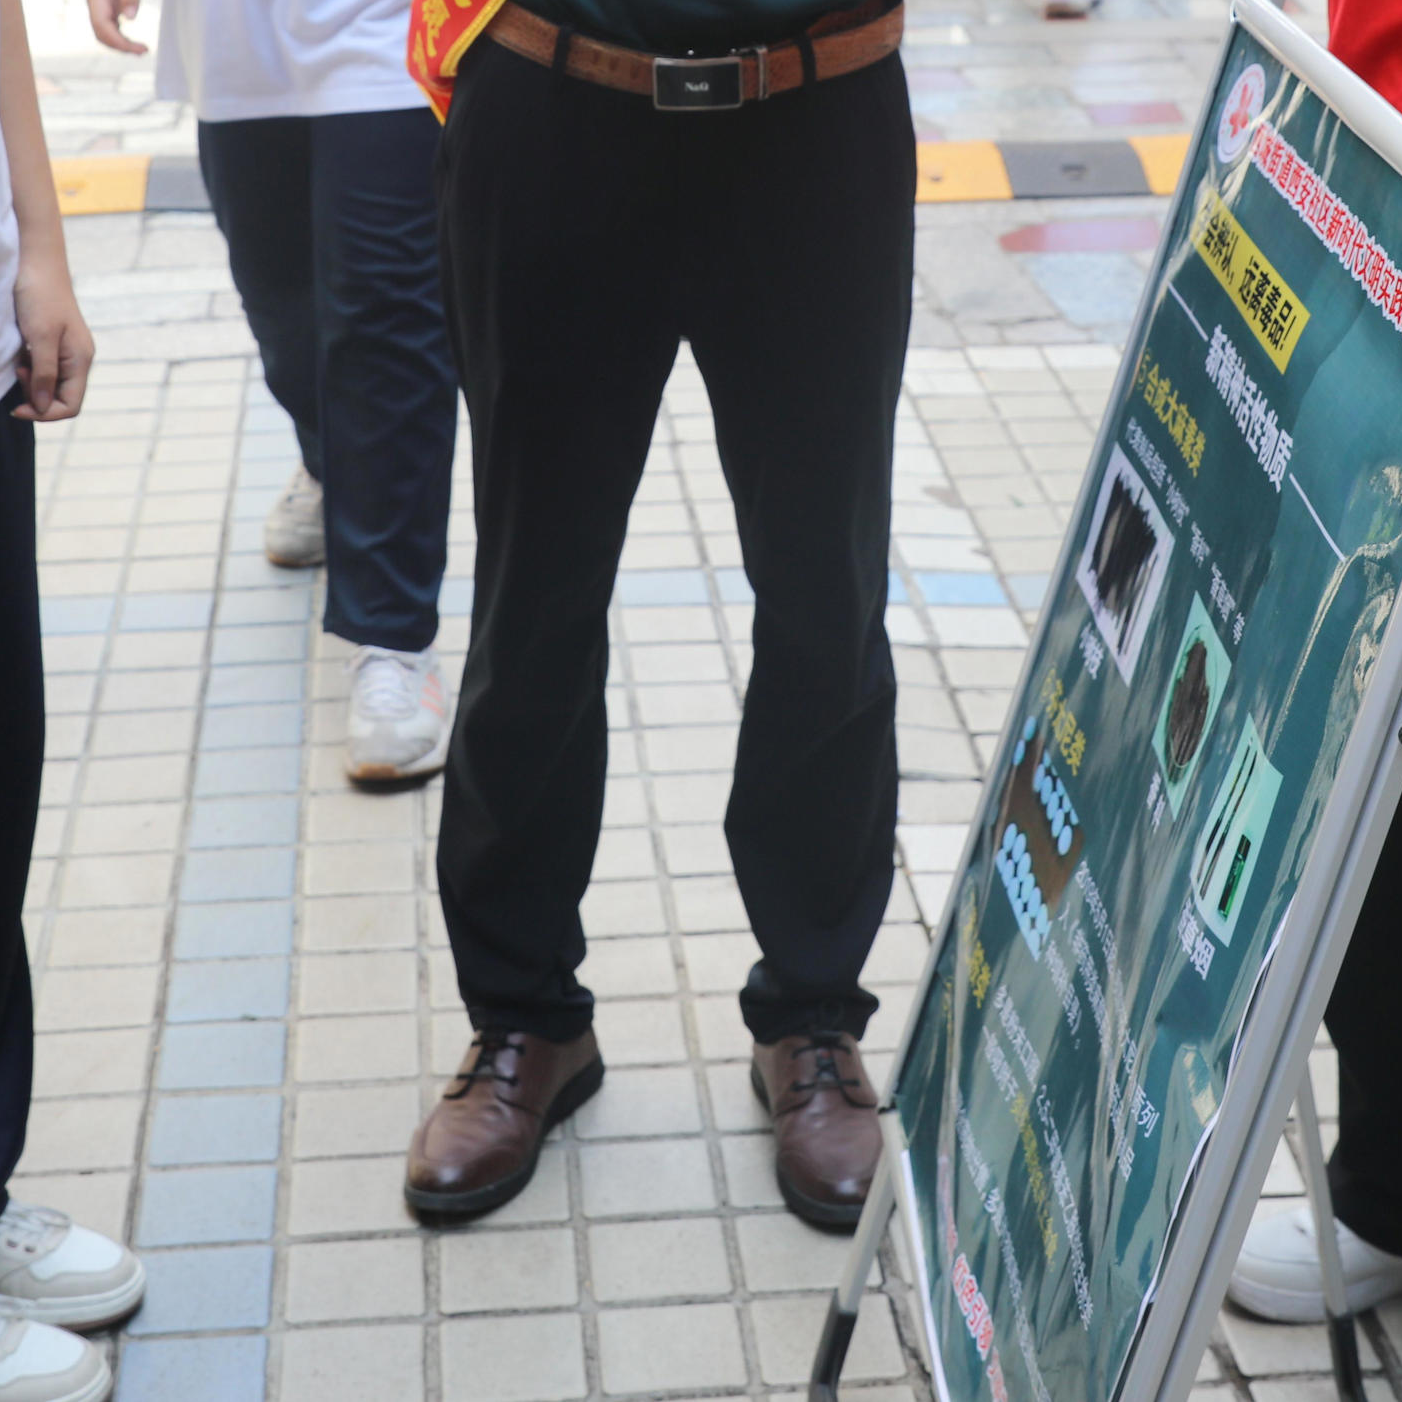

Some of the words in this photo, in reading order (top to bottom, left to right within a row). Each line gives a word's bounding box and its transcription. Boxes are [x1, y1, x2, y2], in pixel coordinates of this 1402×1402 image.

[1205, 324, 1294, 493] 新精神活性物质
